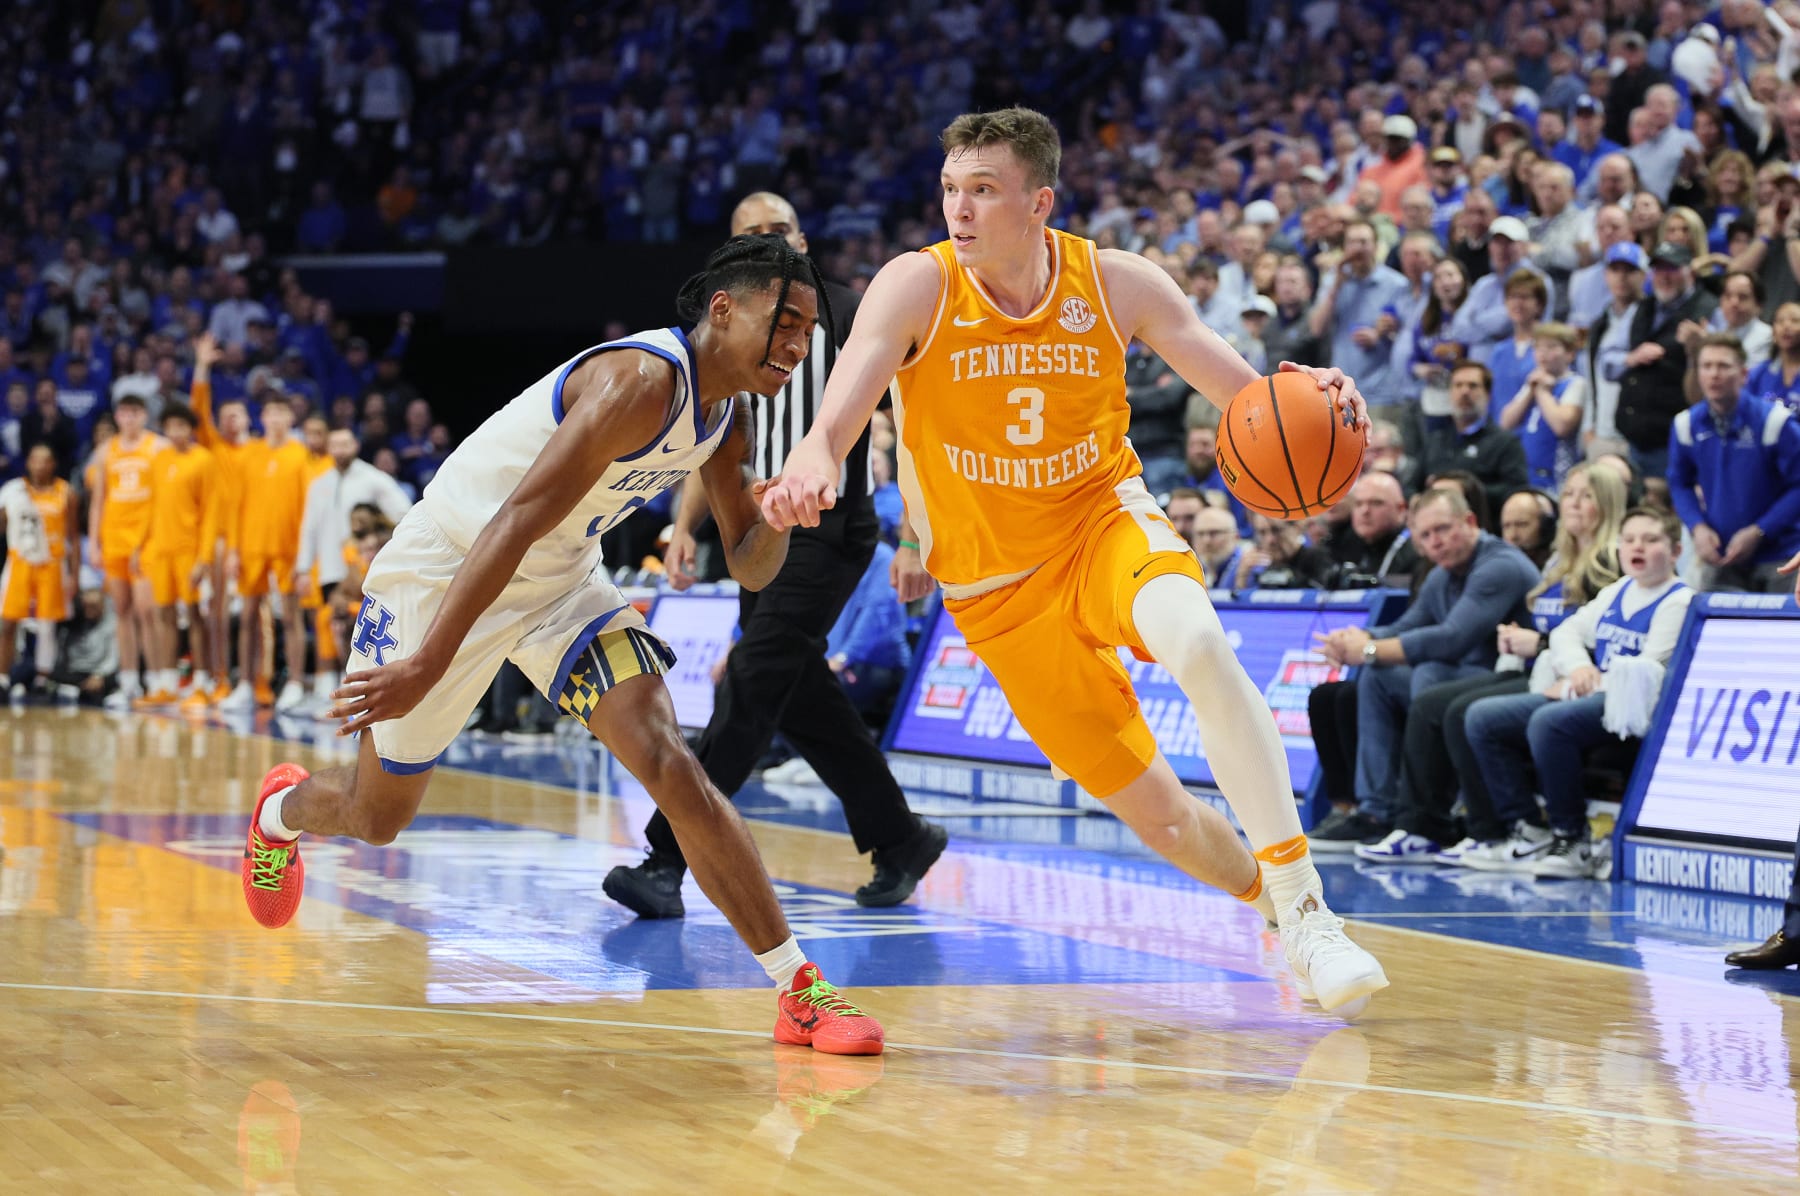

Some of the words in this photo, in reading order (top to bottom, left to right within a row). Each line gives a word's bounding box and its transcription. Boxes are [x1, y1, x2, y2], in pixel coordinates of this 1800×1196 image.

[1062, 298, 1090, 325] SEC
[950, 343, 1100, 382] TENNESSEE
[1005, 387, 1045, 446] 3
[943, 430, 1099, 489] VOLUNTEERS
[1635, 846, 1708, 889] KENTUCKY
[1709, 854, 1750, 895] FARM
[1754, 859, 1794, 899] BURE
